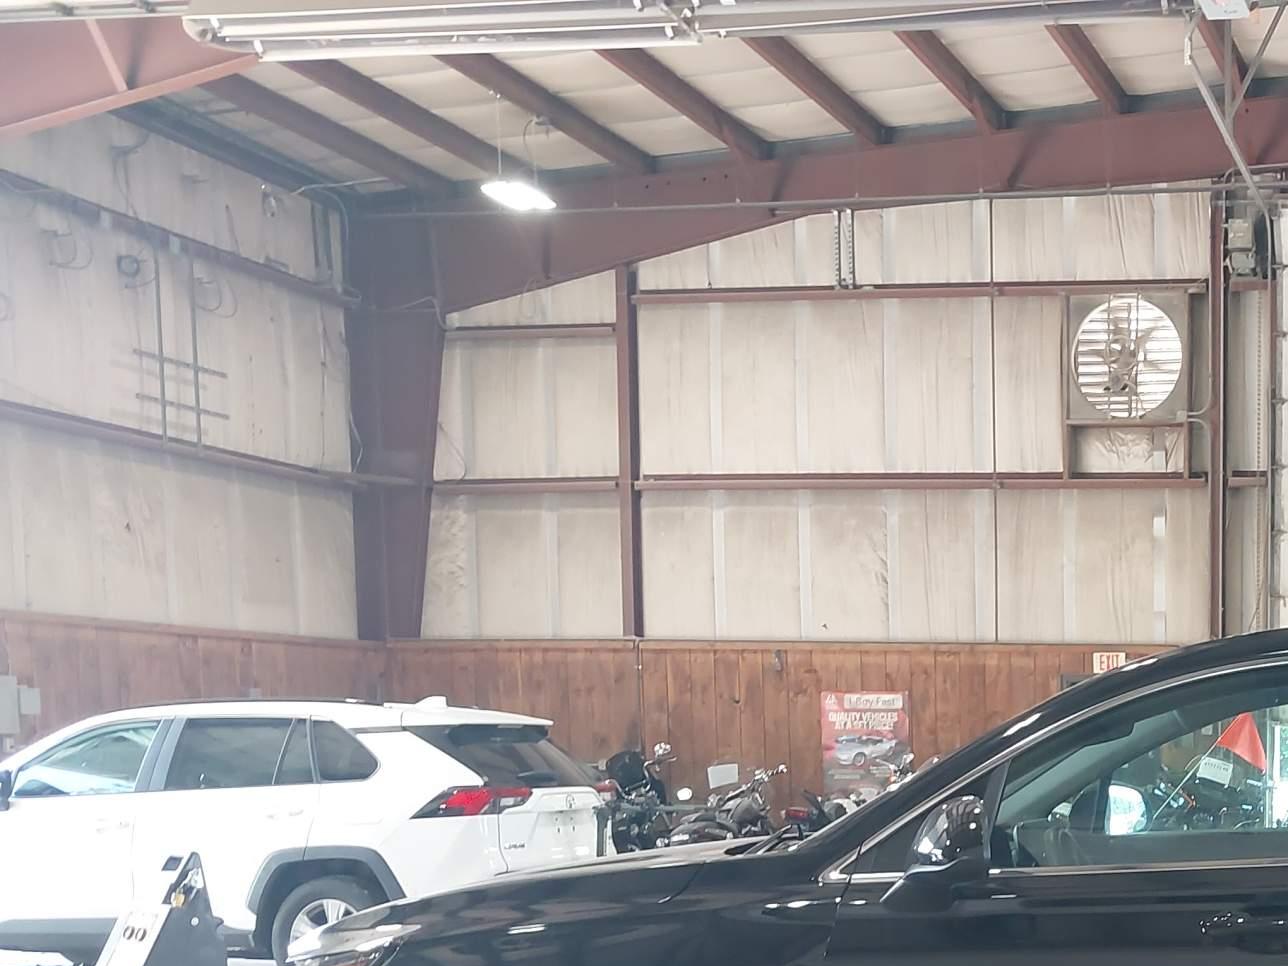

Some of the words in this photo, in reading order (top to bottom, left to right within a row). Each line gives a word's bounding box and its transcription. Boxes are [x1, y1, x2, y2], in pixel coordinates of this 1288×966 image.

[1099, 653, 1120, 671] EXIT
[876, 696, 896, 707] Fast
[828, 711, 861, 722] QUALITY
[862, 711, 898, 722] VEHICLES
